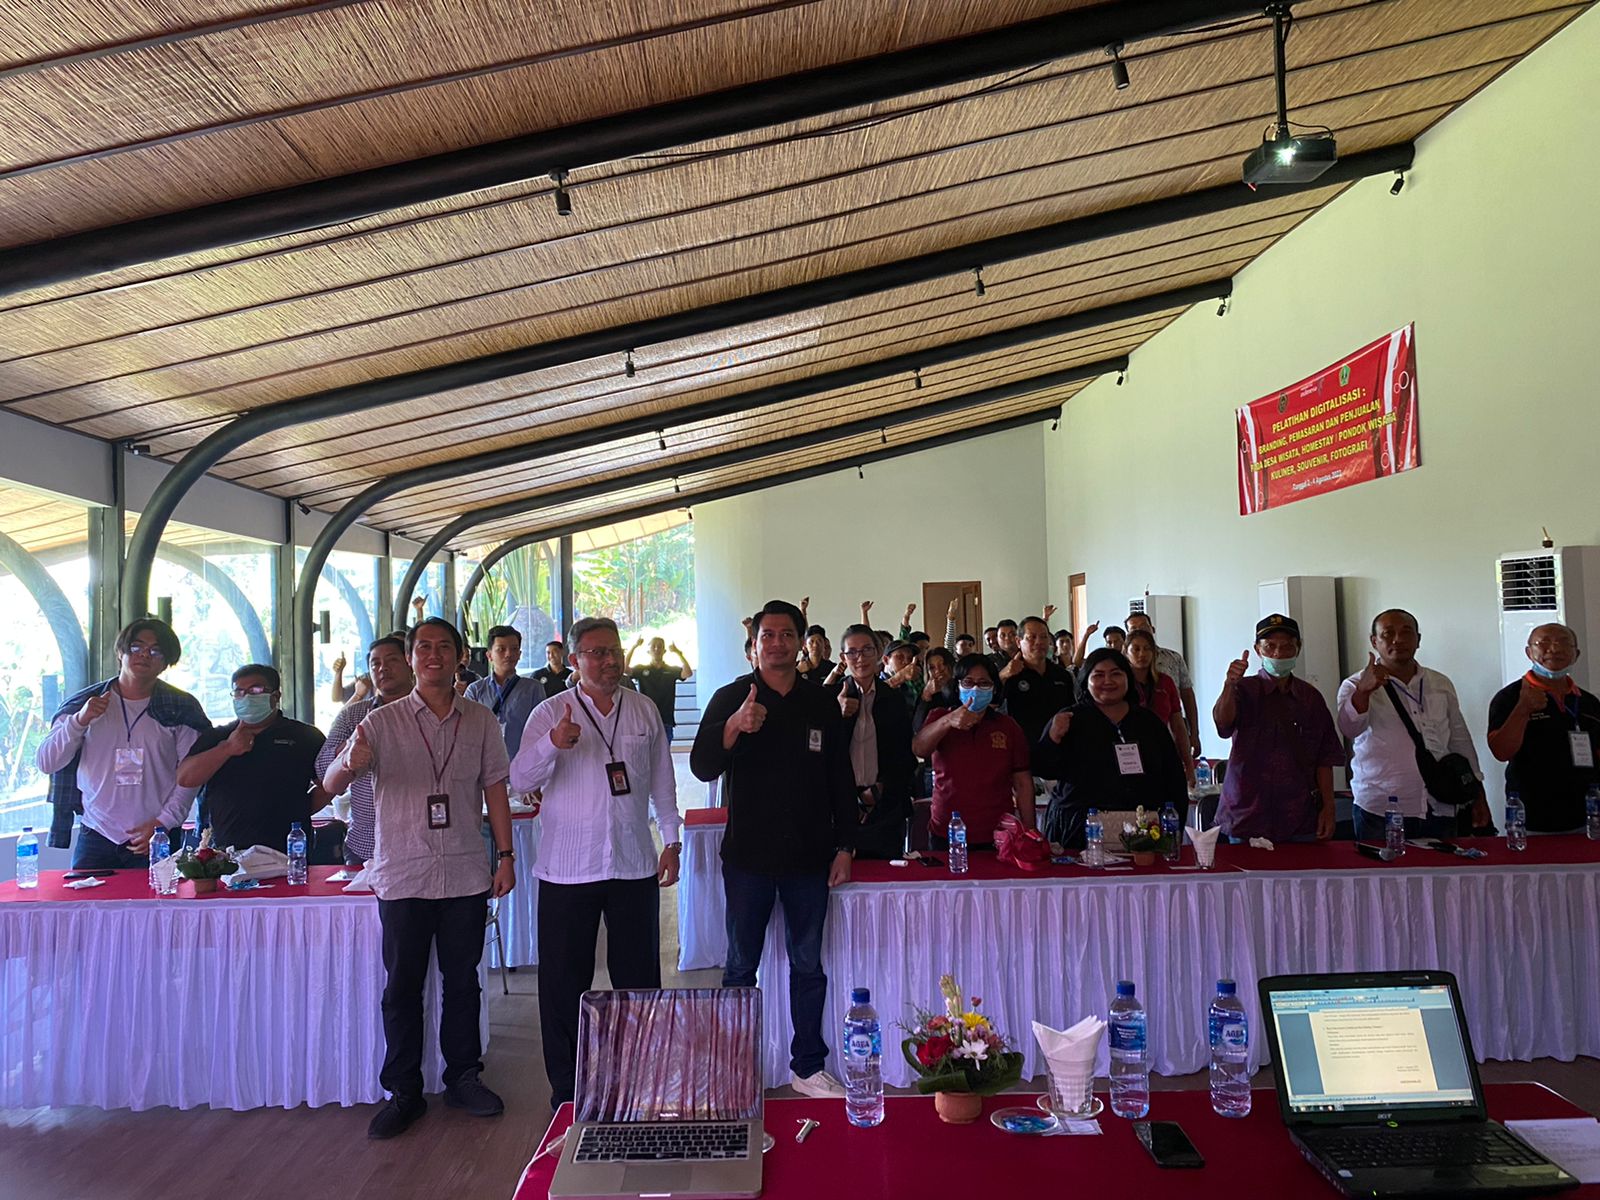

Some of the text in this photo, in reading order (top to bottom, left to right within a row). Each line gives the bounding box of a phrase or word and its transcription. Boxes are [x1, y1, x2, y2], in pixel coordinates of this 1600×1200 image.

[1272, 409, 1309, 434] PELATIHAN
[1310, 387, 1361, 418] DIGITALISASI
[1288, 421, 1325, 443] PEMASARAN
[1325, 415, 1339, 429] DAN
[1340, 398, 1380, 423] PENJUALAN
[1301, 435, 1334, 455] HOMESTAY
[1338, 422, 1367, 441] PONDOK
[1330, 439, 1368, 461] FOTOGRAFI
